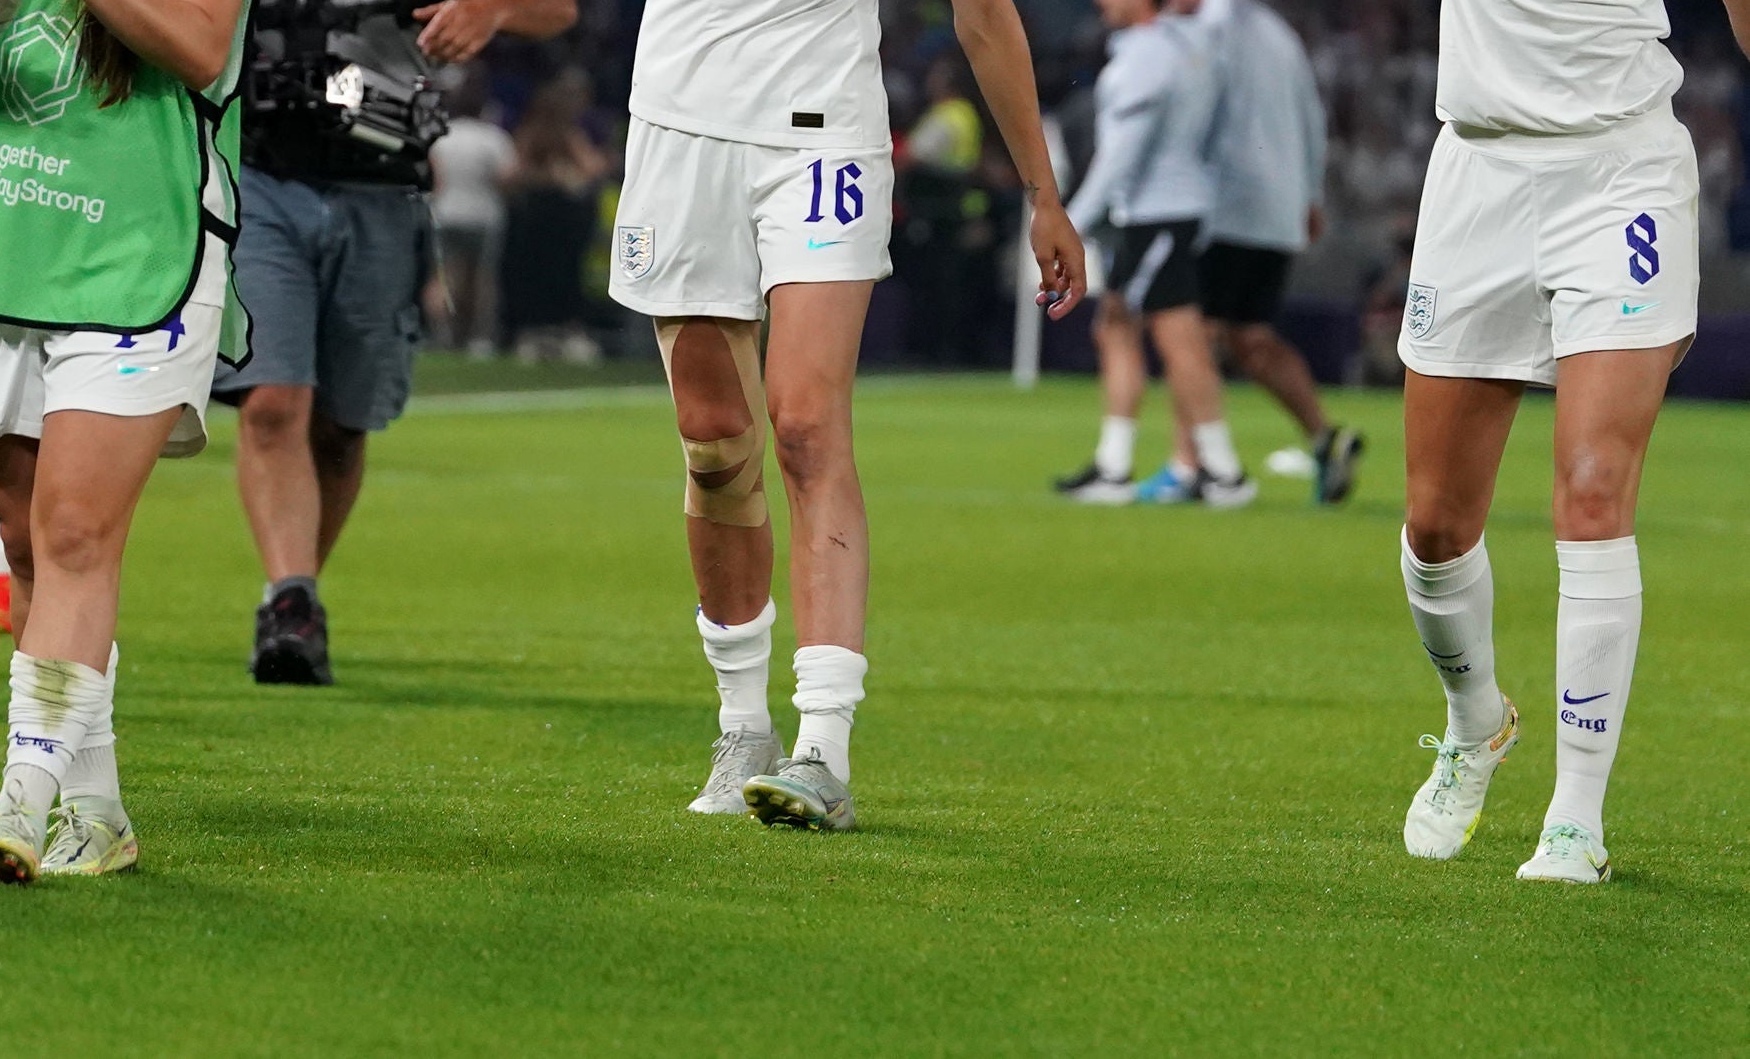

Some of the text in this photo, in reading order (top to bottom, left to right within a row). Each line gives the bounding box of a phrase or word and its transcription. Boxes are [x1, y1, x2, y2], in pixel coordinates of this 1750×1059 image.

[804, 158, 863, 225] 16
[1625, 212, 1659, 285] 8
[1561, 709, 1607, 733] Eng
